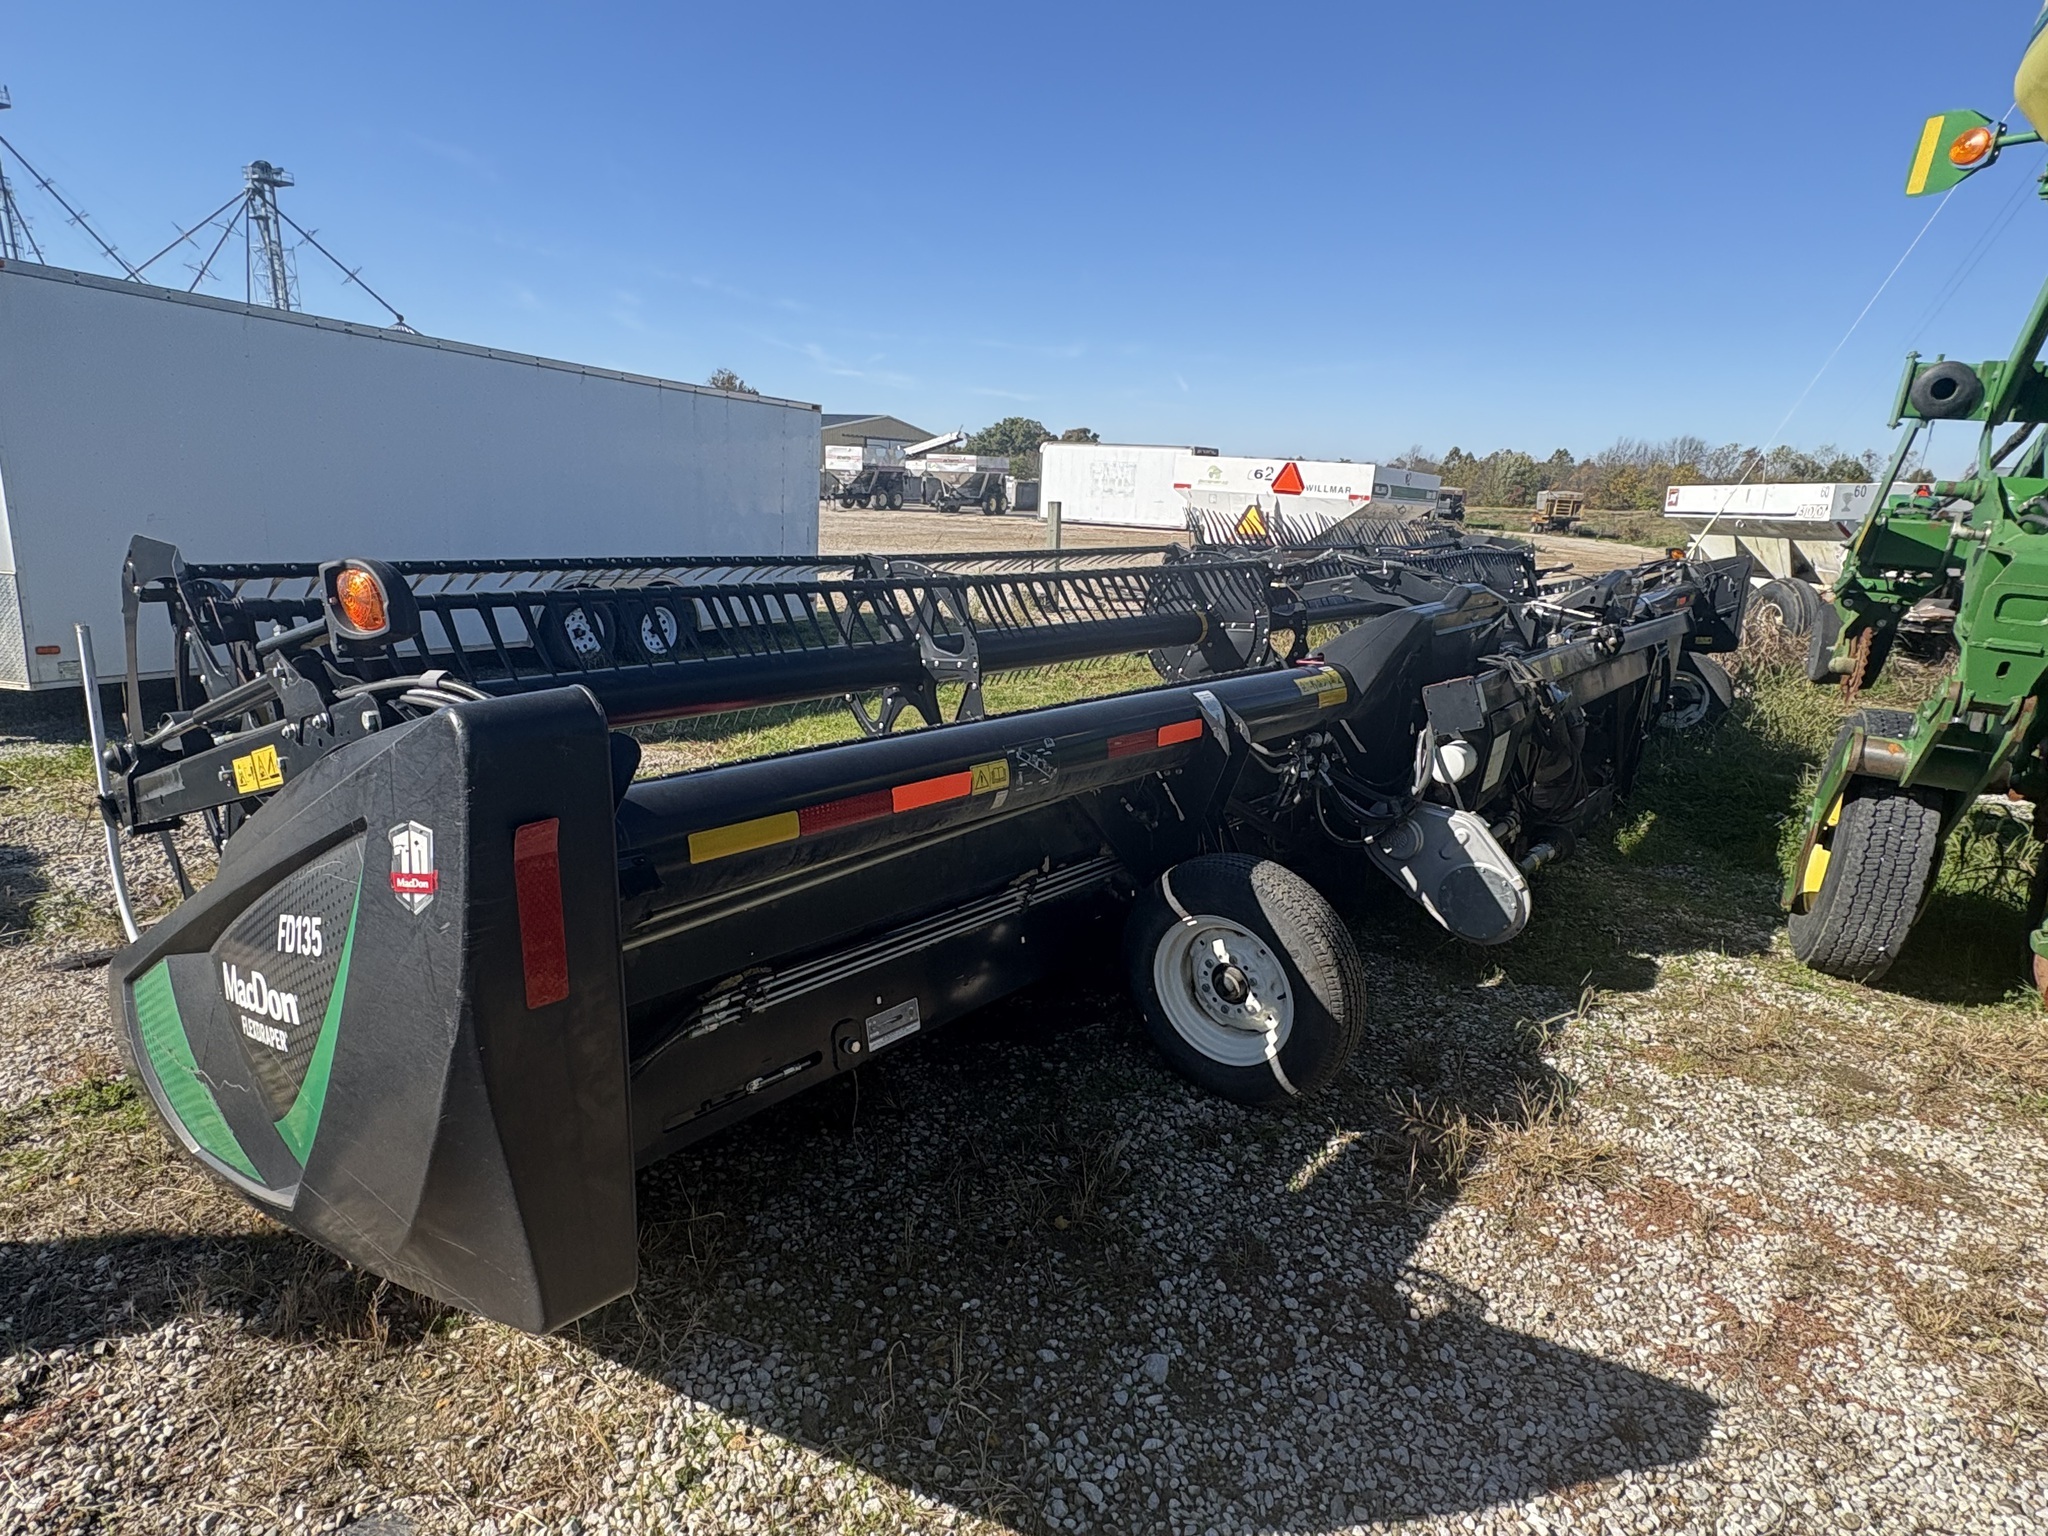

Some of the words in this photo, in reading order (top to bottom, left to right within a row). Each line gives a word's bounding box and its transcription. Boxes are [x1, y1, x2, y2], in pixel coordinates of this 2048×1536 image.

[1305, 484, 1352, 495] WILLMAR
[1854, 485, 1867, 498] 60
[396, 878, 429, 889] MacDon
[277, 914, 322, 957] FD135
[222, 961, 300, 1026] MacDon
